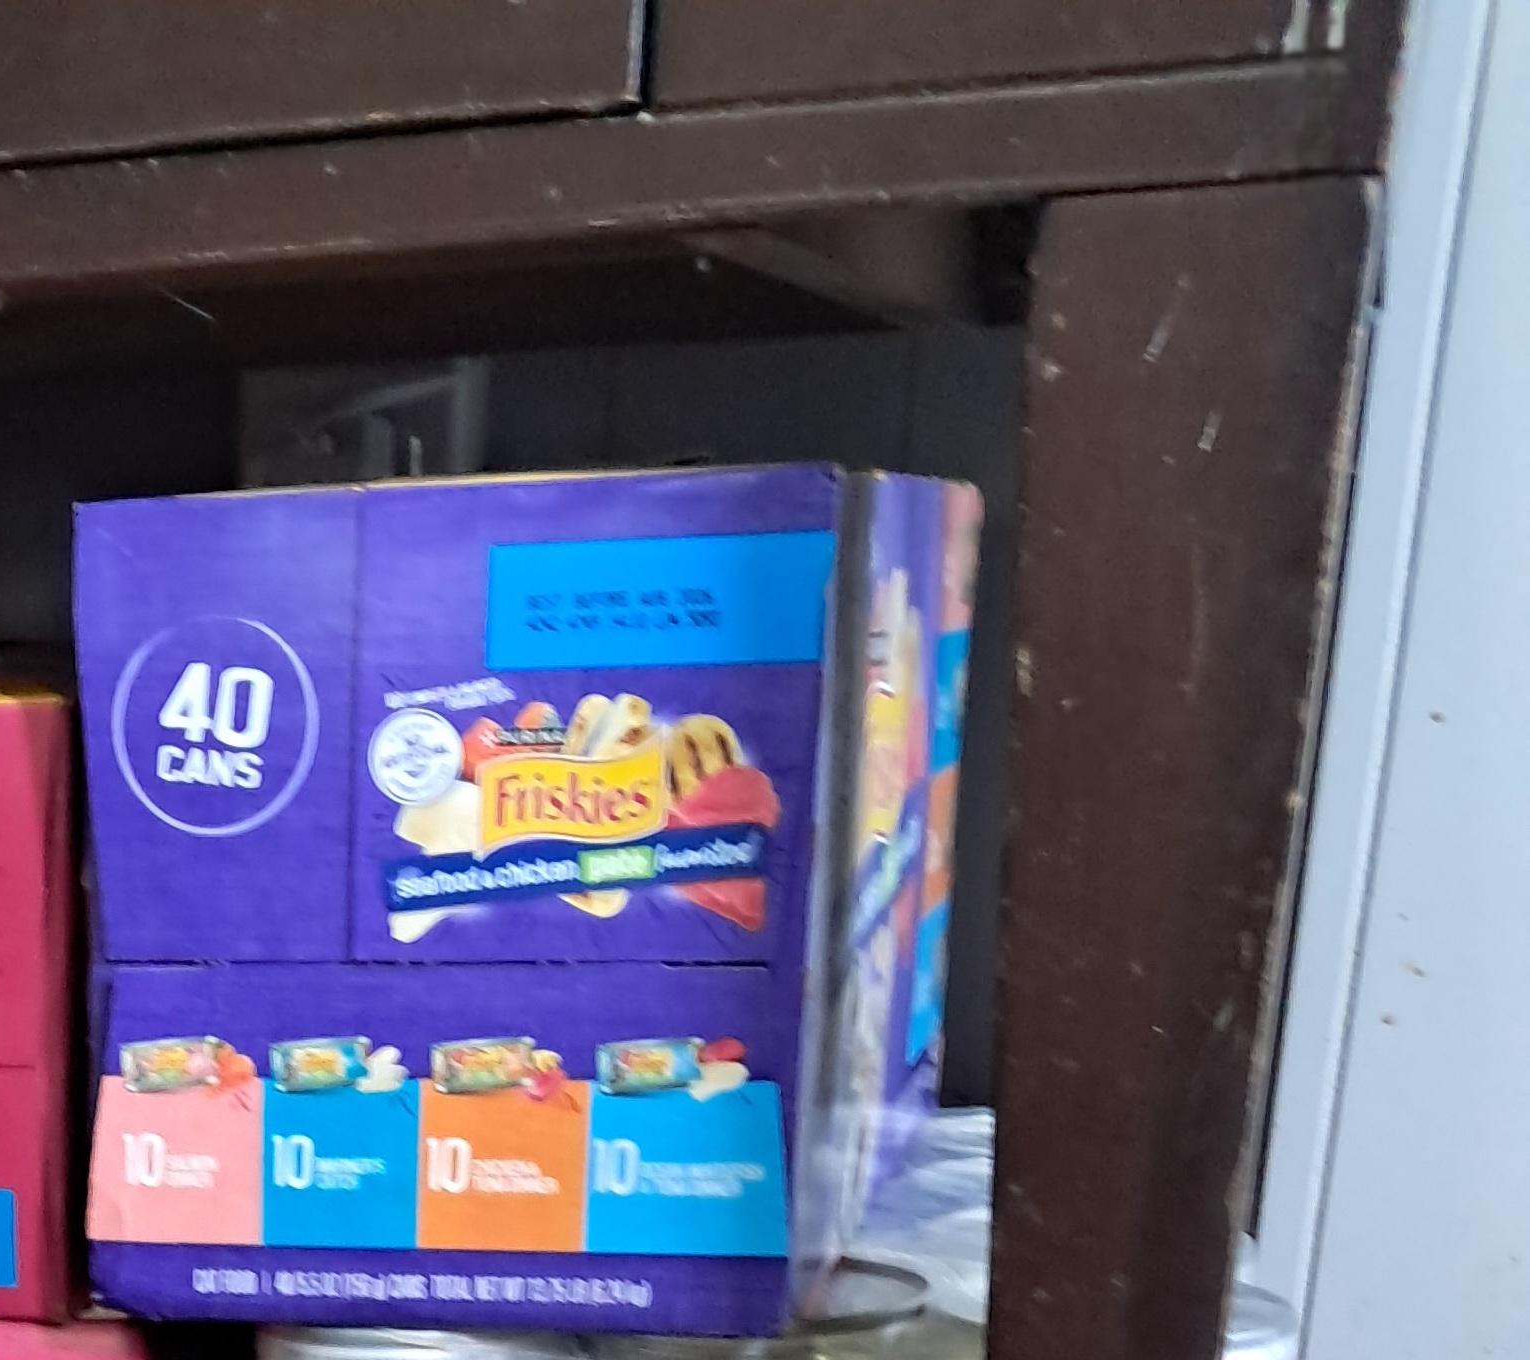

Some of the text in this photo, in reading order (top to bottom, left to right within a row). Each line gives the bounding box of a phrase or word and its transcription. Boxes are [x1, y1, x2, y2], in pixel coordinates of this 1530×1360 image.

[159, 662, 274, 748] 40
[157, 745, 264, 789] CANS
[495, 771, 651, 827] Friskies
[122, 1133, 166, 1188] 10
[272, 1134, 315, 1189] 10
[425, 1137, 471, 1194] 10
[592, 1138, 640, 1195] 10
